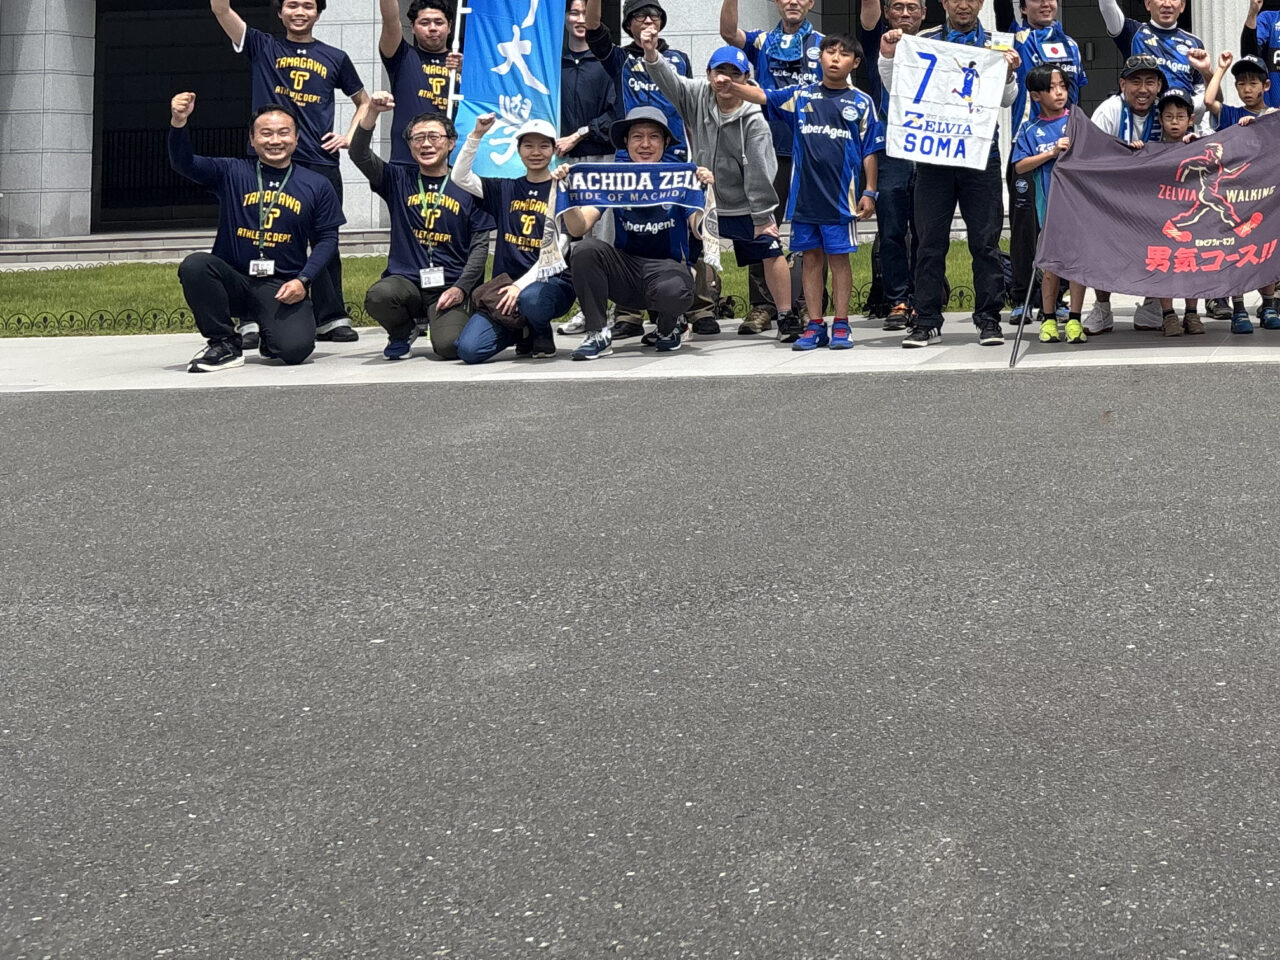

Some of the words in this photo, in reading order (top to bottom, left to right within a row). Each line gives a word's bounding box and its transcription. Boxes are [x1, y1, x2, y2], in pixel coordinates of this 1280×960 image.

[276, 56, 329, 80] TAMAGAWA
[1152, 55, 1191, 72] erAgent
[912, 51, 938, 104] 7
[903, 110, 973, 136] ZELVIA
[903, 132, 966, 159] SOMA
[607, 193, 624, 202] OF
[630, 189, 687, 202] MACHIDA
[1158, 184, 1198, 202] ZELVIA
[1226, 185, 1277, 203] WALKING
[509, 198, 549, 216] TAMAGAW
[237, 227, 272, 241] ATHLEIC
[619, 218, 676, 234] berAgent
